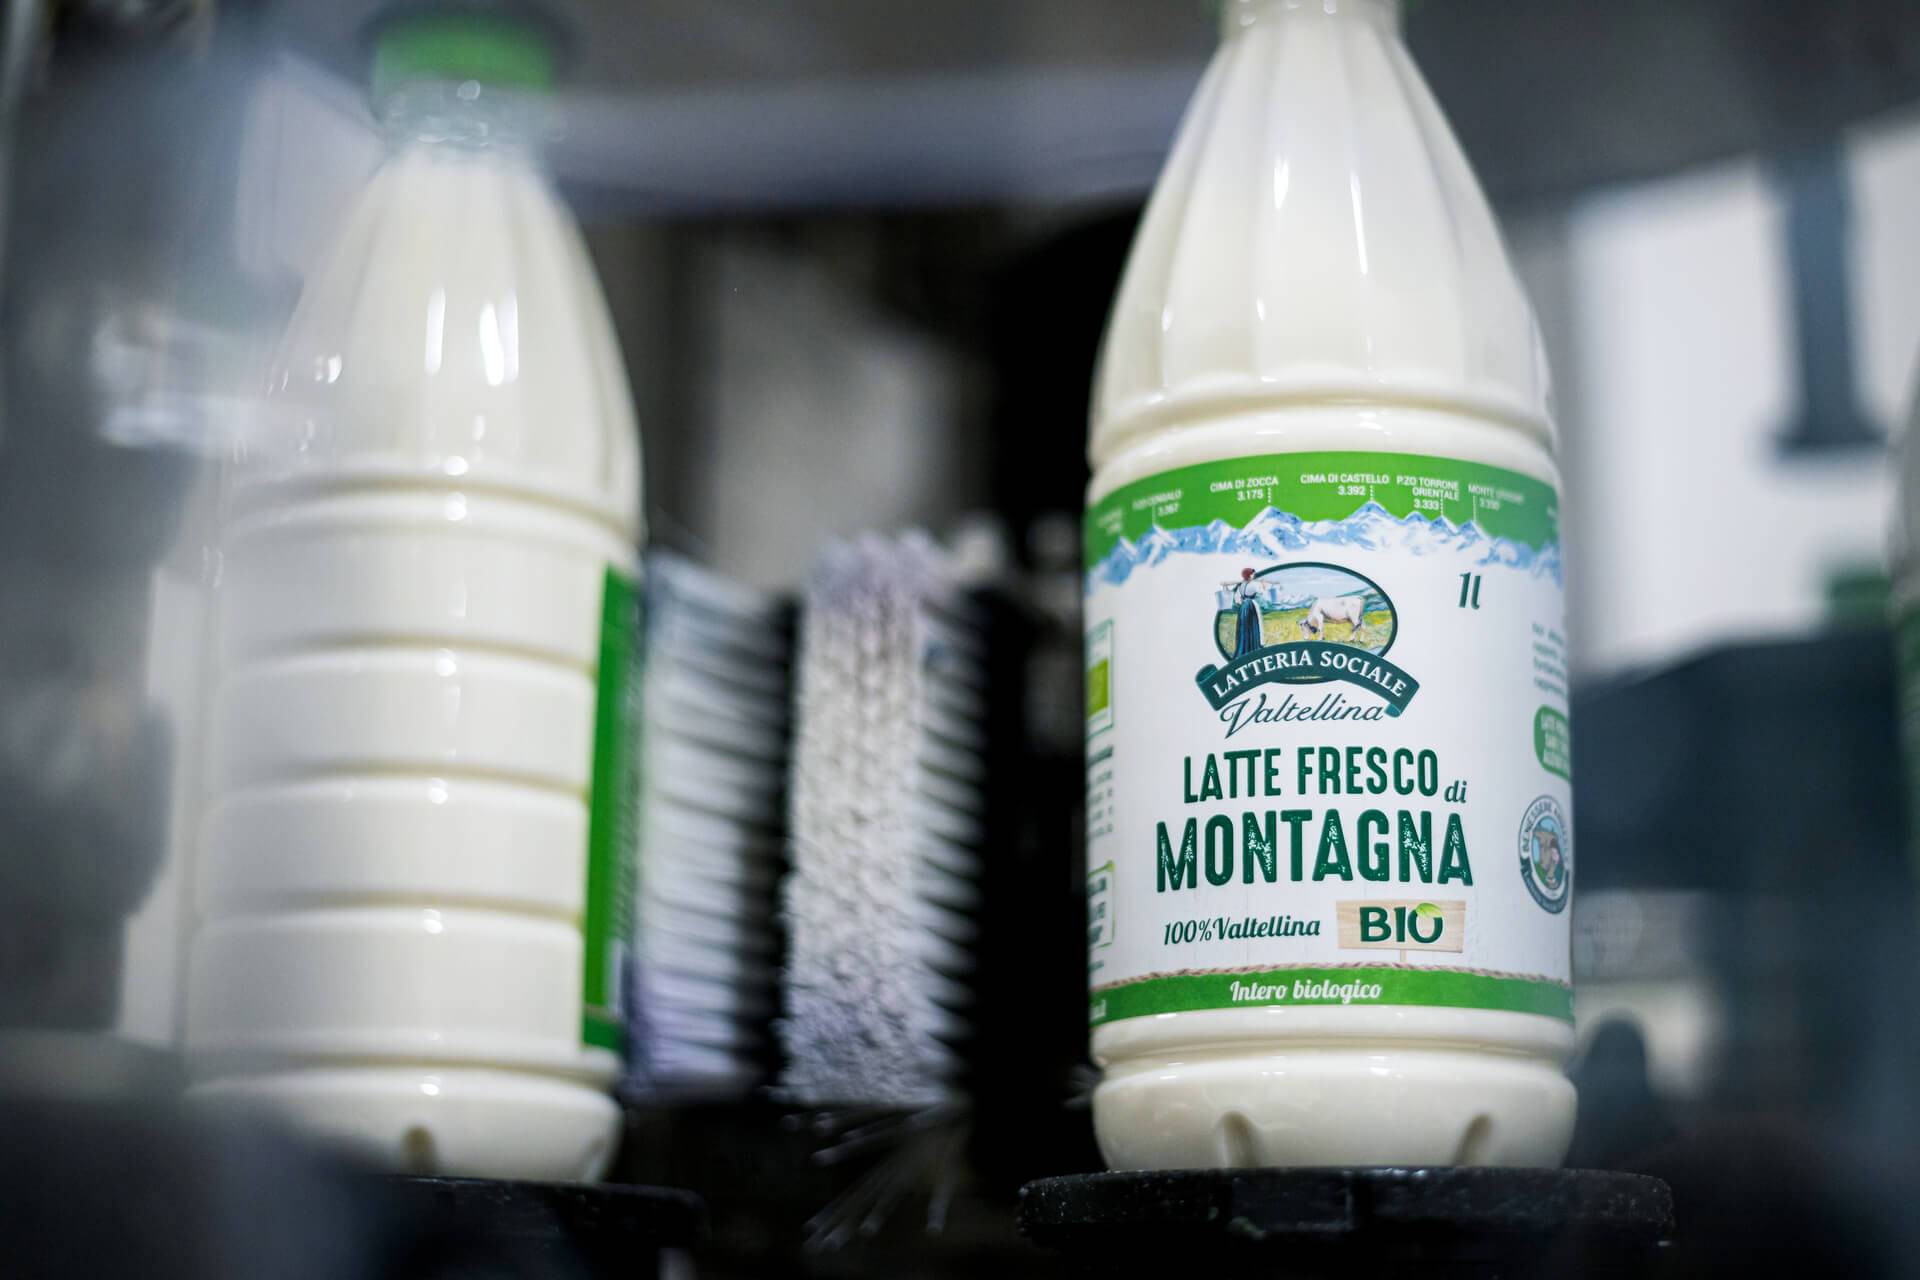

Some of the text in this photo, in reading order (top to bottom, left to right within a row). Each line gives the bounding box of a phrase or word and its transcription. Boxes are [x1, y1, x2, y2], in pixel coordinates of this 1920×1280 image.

[1210, 476, 1278, 492] CIMA DI ZOCCA
[1300, 474, 1390, 485] CIMA DI CASTELLO
[1338, 486, 1366, 496] 3.392
[1419, 477, 1459, 491] TORRONE
[1412, 487, 1459, 502] ORIENTALE
[1212, 650, 1407, 698] LATTERIA SOCIALE
[1220, 692, 1384, 740] Valtellina
[1184, 746, 1467, 804] LATTE FRESCO di
[1156, 808, 1473, 893] MONTAGNA
[1359, 905, 1444, 944] BIO
[1229, 979, 1382, 1005] Intero biologico
